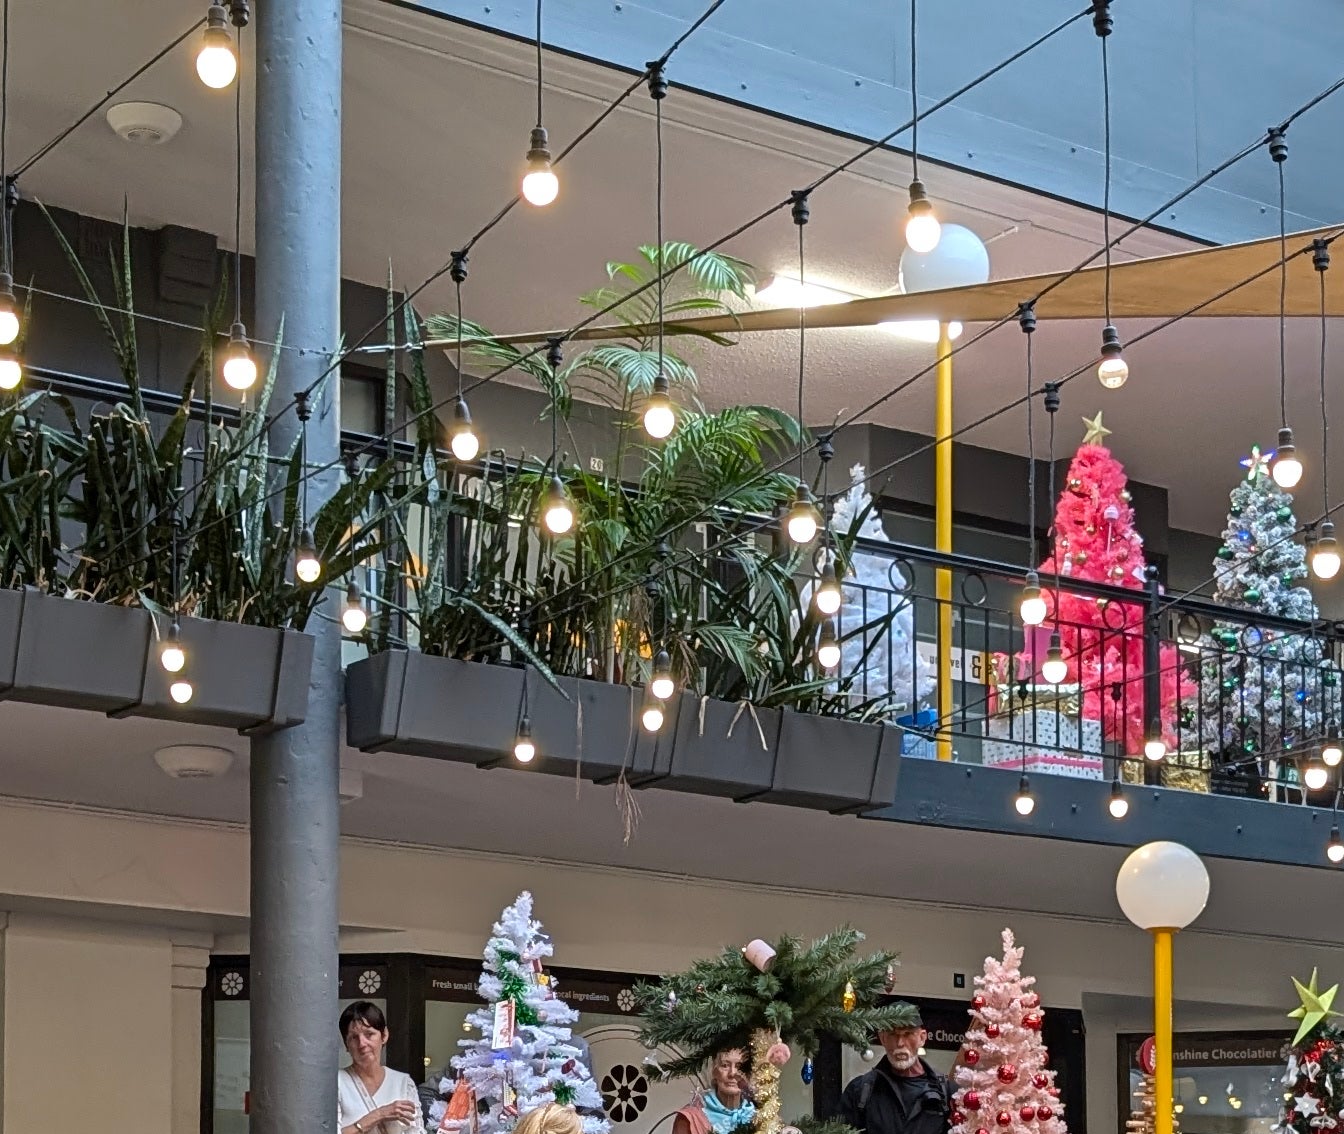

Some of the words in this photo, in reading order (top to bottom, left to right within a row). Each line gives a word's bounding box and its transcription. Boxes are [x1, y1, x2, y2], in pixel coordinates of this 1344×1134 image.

[432, 979, 452, 989] Fresh
[572, 991, 610, 1003] ingredients
[1173, 1049, 1209, 1061] nshine
[1211, 1047, 1277, 1061] Chocolatier
